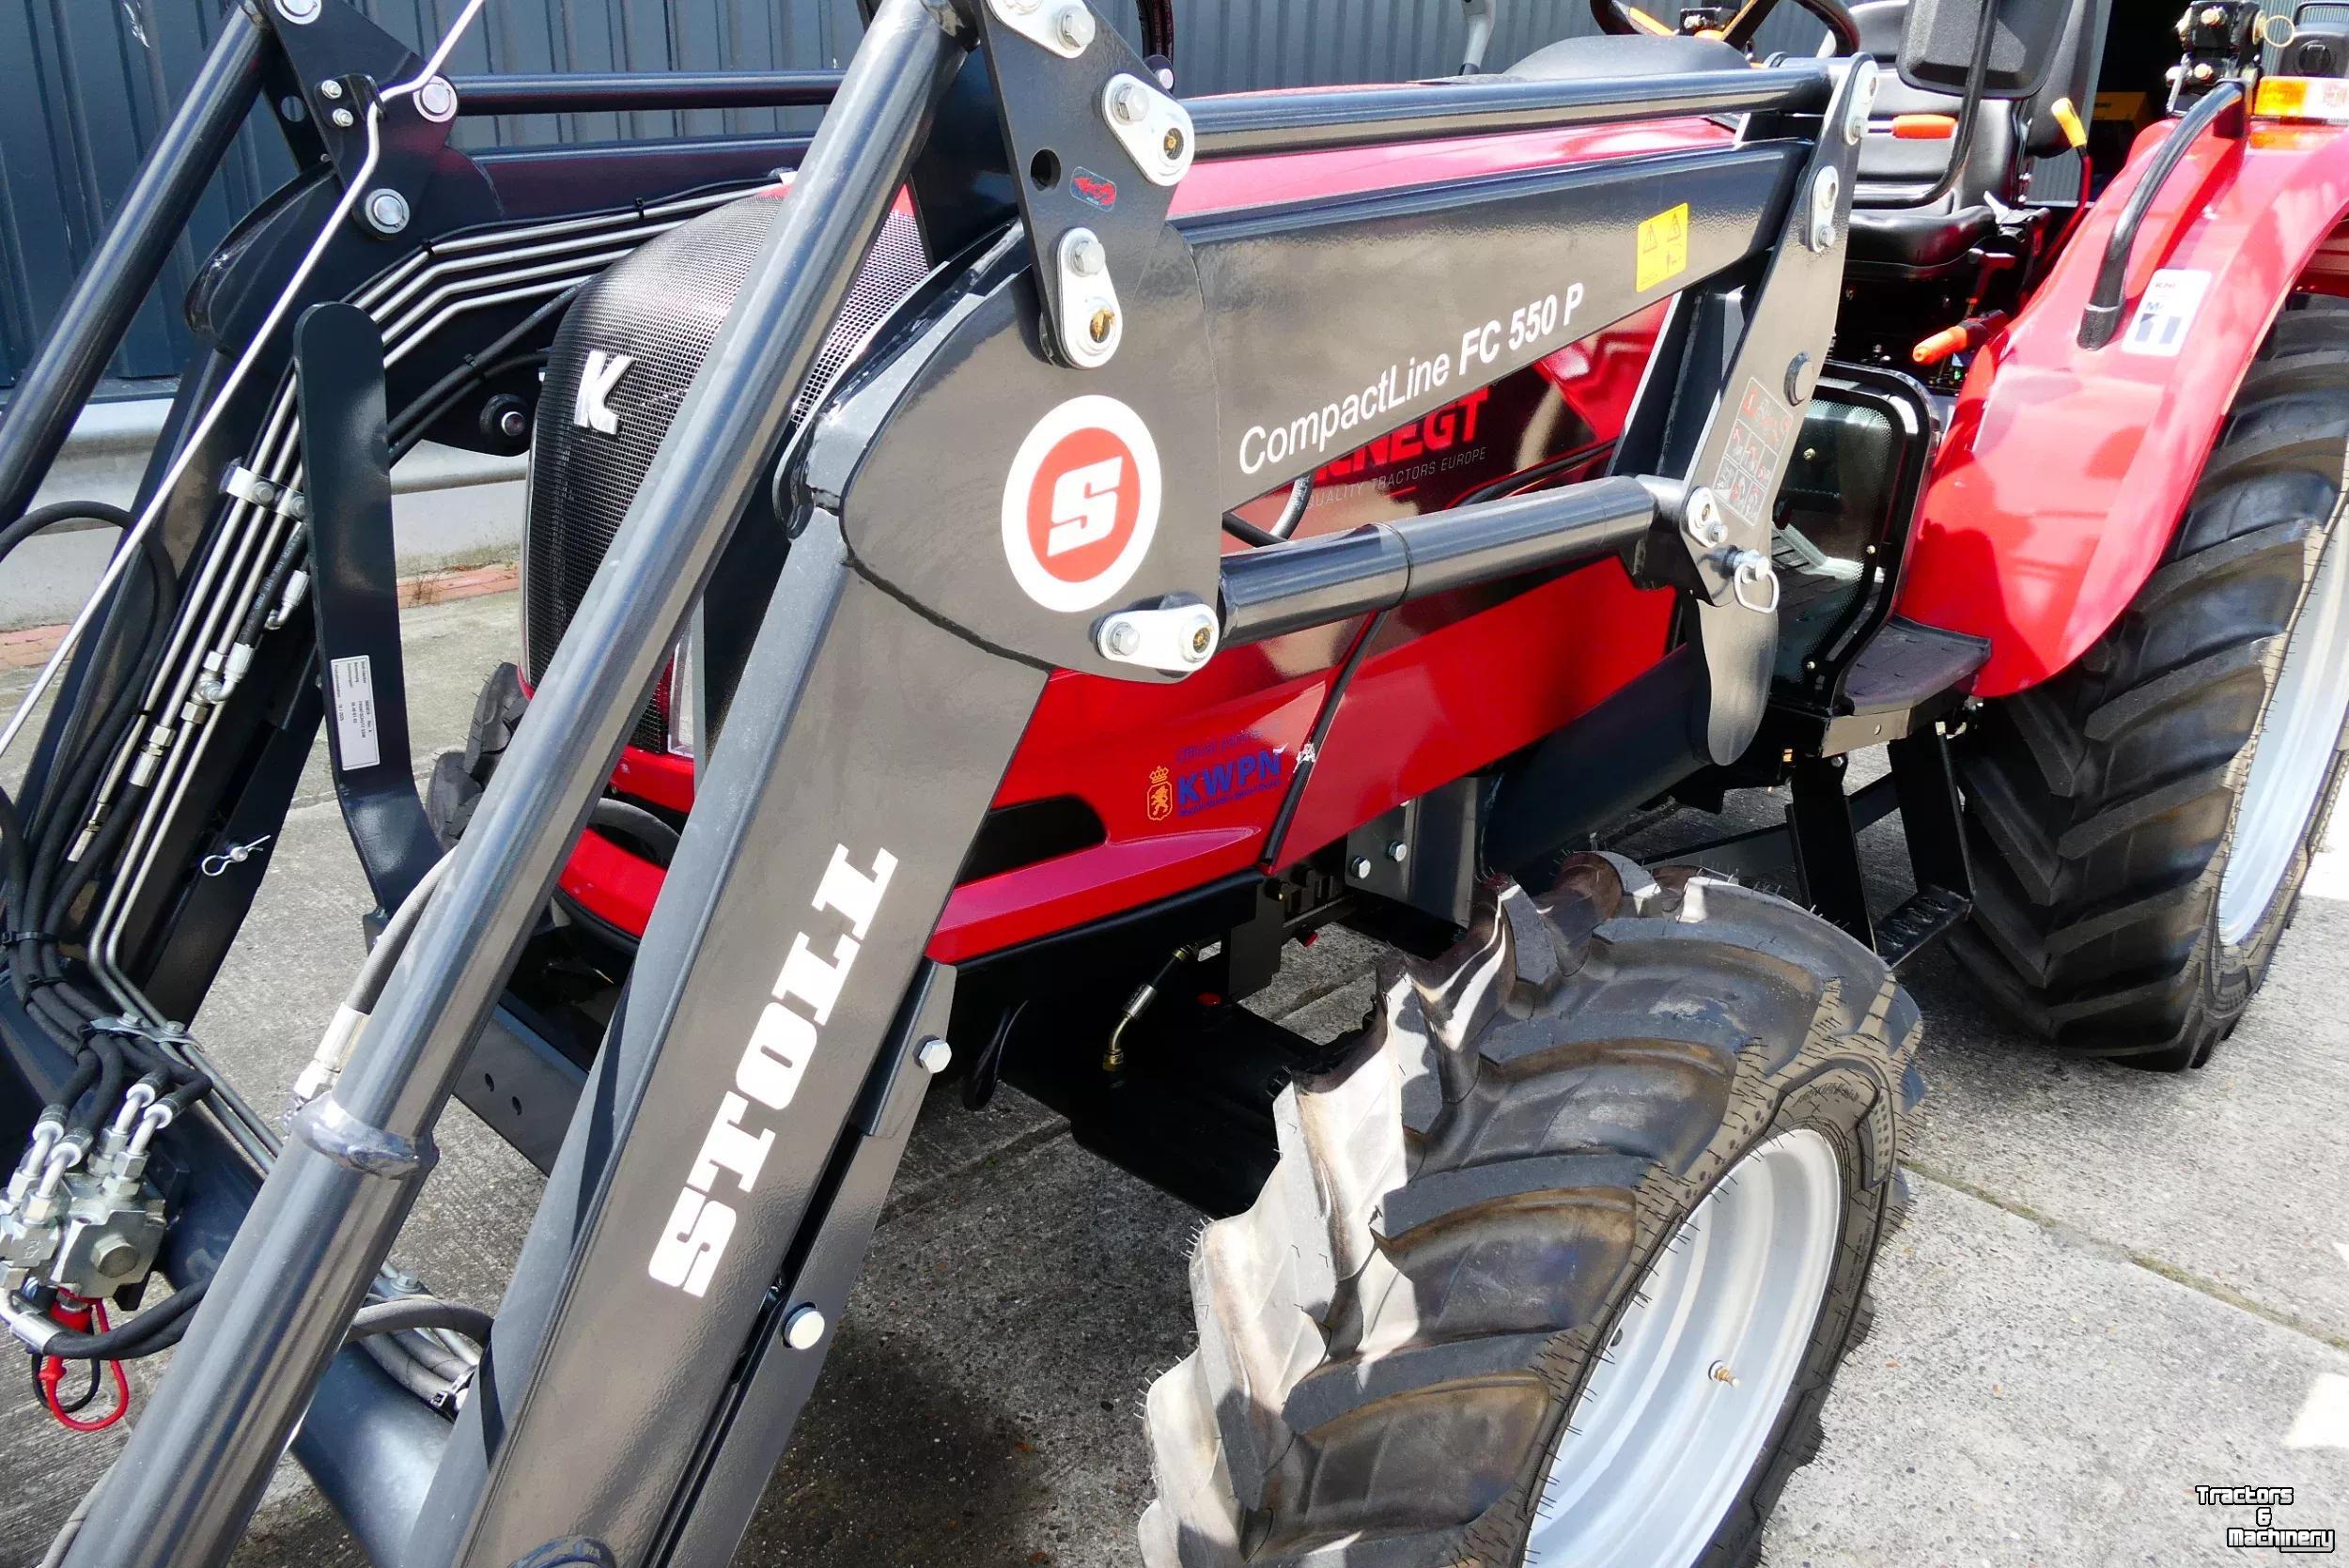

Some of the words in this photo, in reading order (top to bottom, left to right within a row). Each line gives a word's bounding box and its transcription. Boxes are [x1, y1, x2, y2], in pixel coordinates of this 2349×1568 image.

[573, 349, 635, 435] K
[1239, 352, 1451, 475] CompactLine
[1458, 319, 1501, 376] FC
[1508, 293, 1557, 351] 550
[1563, 282, 1584, 326] P
[1047, 455, 1124, 557] S
[1440, 446, 1487, 472] EUROPE
[1177, 750, 1282, 806] KWPN
[648, 842, 899, 1298] STOLL
